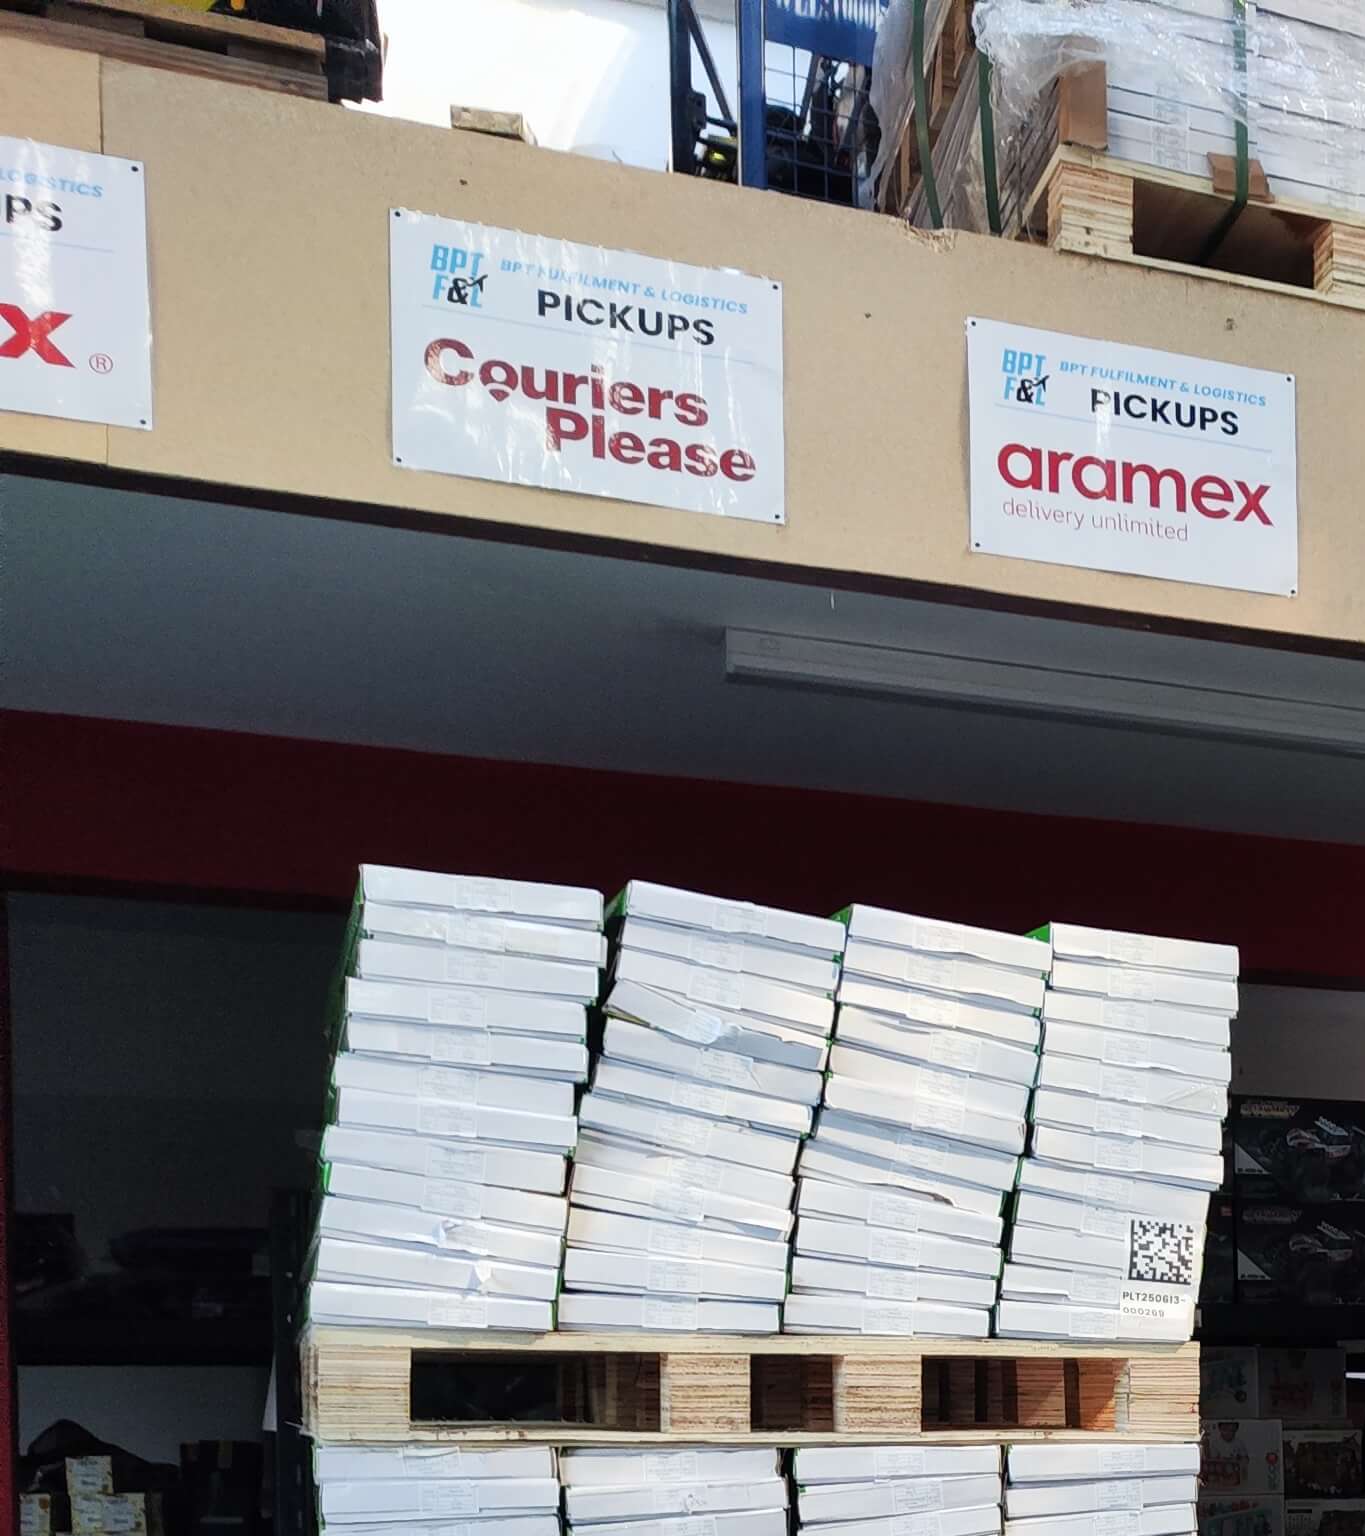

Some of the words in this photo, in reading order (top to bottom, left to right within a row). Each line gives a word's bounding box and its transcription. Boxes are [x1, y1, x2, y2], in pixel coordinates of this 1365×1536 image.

[430, 244, 484, 277] BPT
[500, 258, 532, 275] BPT
[644, 286, 655, 298] &
[661, 287, 749, 315] LOGISTICS
[537, 289, 715, 346] PICKUPS
[424, 338, 709, 427] Couriers
[1002, 348, 1046, 377] BPT
[1059, 360, 1088, 375] BPT
[1091, 366, 1178, 391] FULFILMENT
[1180, 382, 1189, 393] &
[1194, 383, 1267, 407] LOGISTICS
[1091, 388, 1239, 435] PICKUPS
[545, 406, 757, 482] Please
[997, 443, 1274, 527] aramex
[1002, 497, 1084, 530] delivery
[1091, 512, 1188, 541] unlimited
